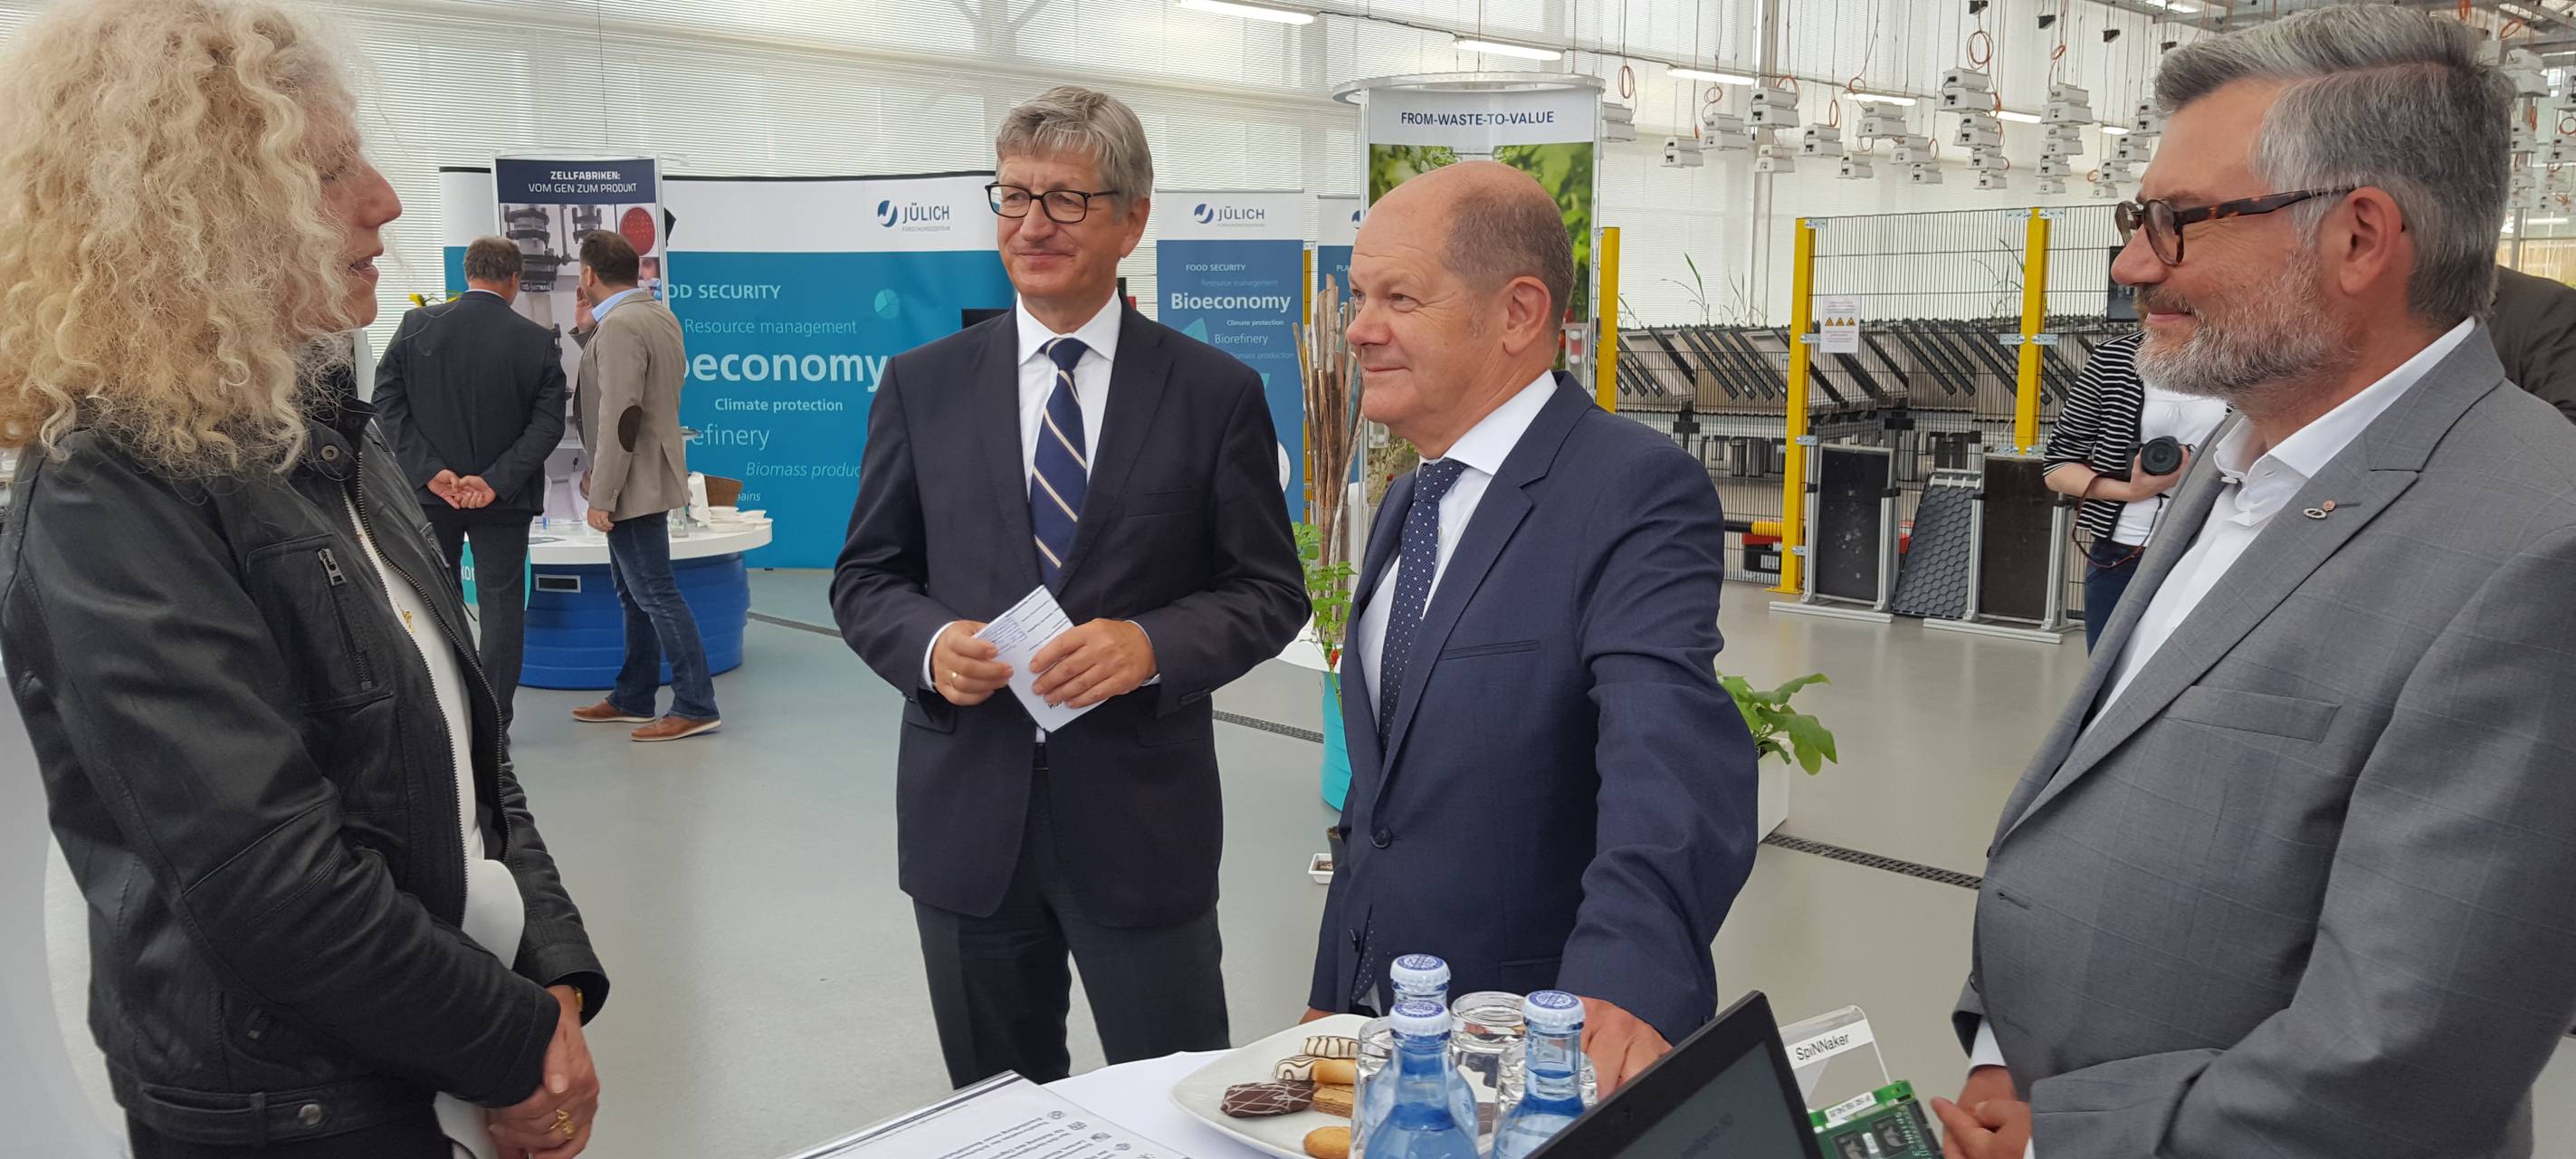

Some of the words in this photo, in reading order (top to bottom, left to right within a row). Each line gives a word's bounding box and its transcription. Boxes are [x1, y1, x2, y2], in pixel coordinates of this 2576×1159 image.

[1401, 111, 1555, 126] FROM-WASTE-TO-VALUE
[550, 171, 621, 180] ZELLFABRIKEN:
[528, 183, 552, 193] VOM
[554, 184, 575, 193] GEN
[577, 184, 598, 193] ZUM
[600, 183, 637, 193] PRODUKT
[902, 202, 950, 225] JÜLICH
[1217, 206, 1265, 222] JÜLICH
[669, 283, 692, 299] OD
[699, 284, 781, 299] SECURITY
[1170, 292, 1292, 313] Bioeconomy
[684, 319, 756, 334] Resource
[760, 321, 857, 338] management
[1251, 320, 1283, 328] protection
[1215, 332, 1268, 346] Biorefinery
[684, 353, 889, 393] economy
[715, 398, 768, 411] Climate
[773, 399, 844, 413] protection
[692, 423, 770, 450] efinery
[746, 462, 807, 477] Biomass
[811, 462, 862, 480] produc
[739, 491, 761, 502] ains
[1795, 1034, 1850, 1061] SpiNNaker
